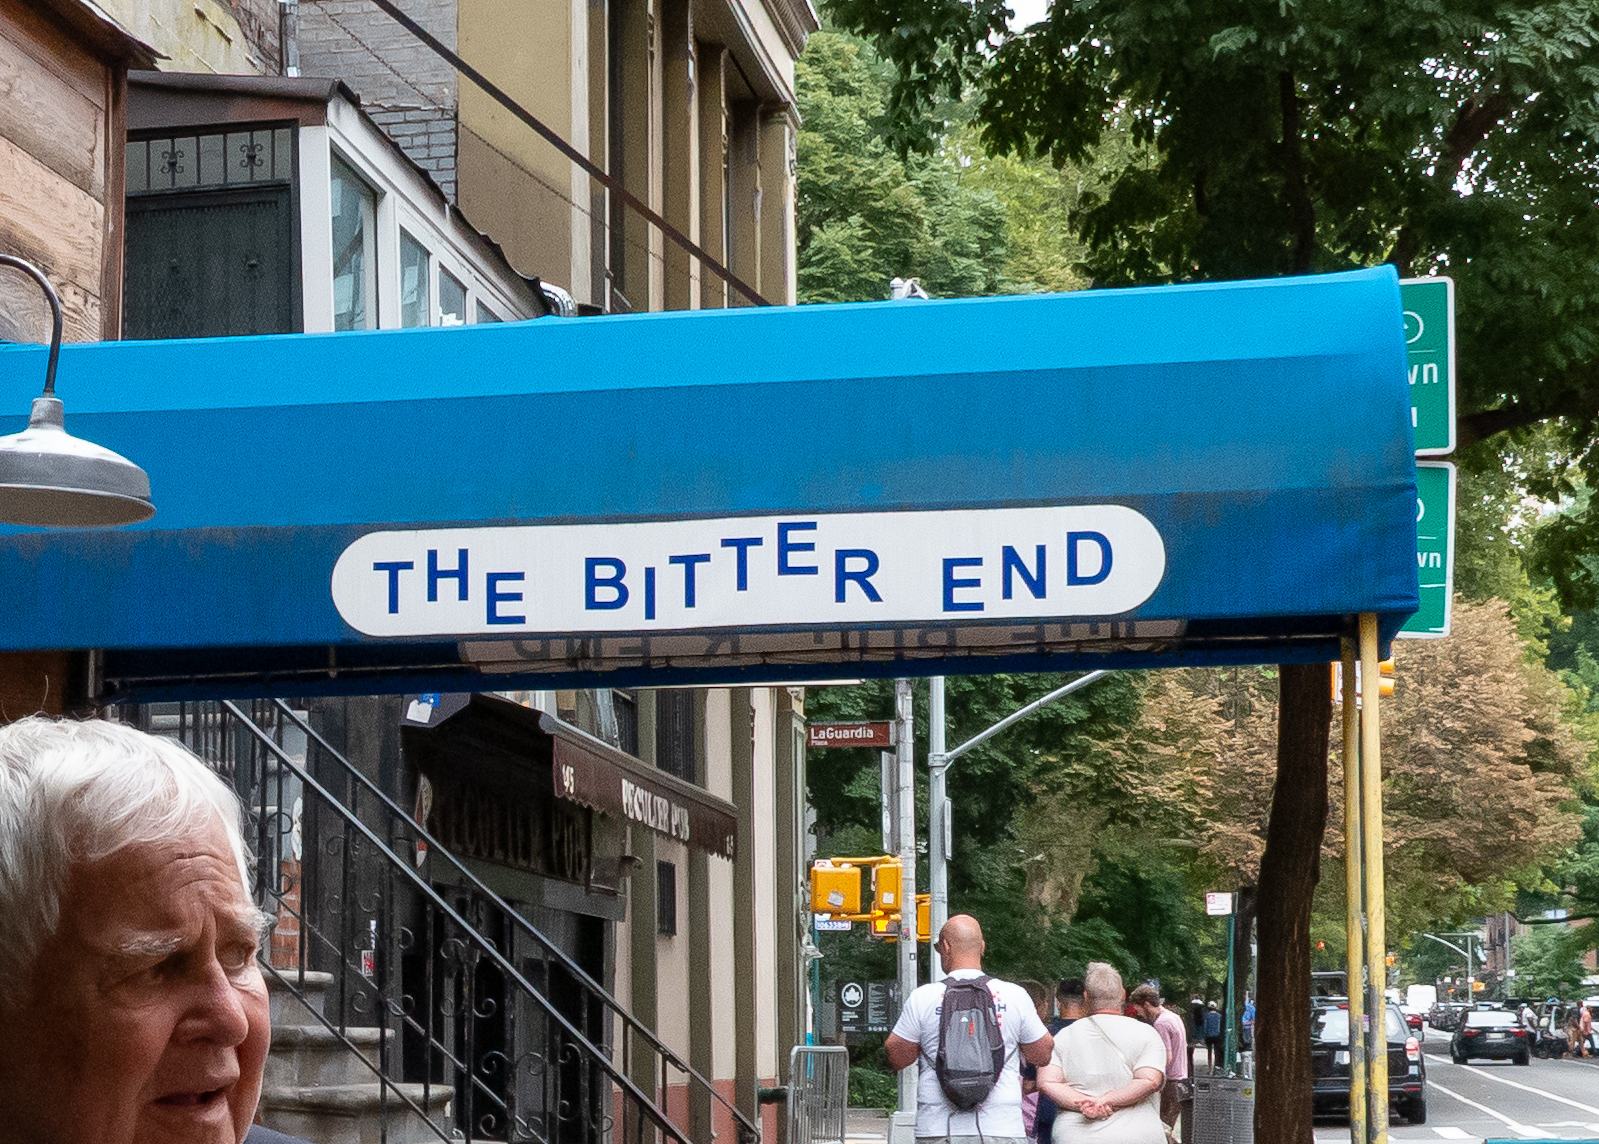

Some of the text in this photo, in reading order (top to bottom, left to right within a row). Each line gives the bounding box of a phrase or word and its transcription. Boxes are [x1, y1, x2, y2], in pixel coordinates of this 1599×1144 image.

[372, 521, 1114, 626] THE BITTER END
[810, 727, 874, 739] LaGuardia
[671, 803, 690, 841] PUB
